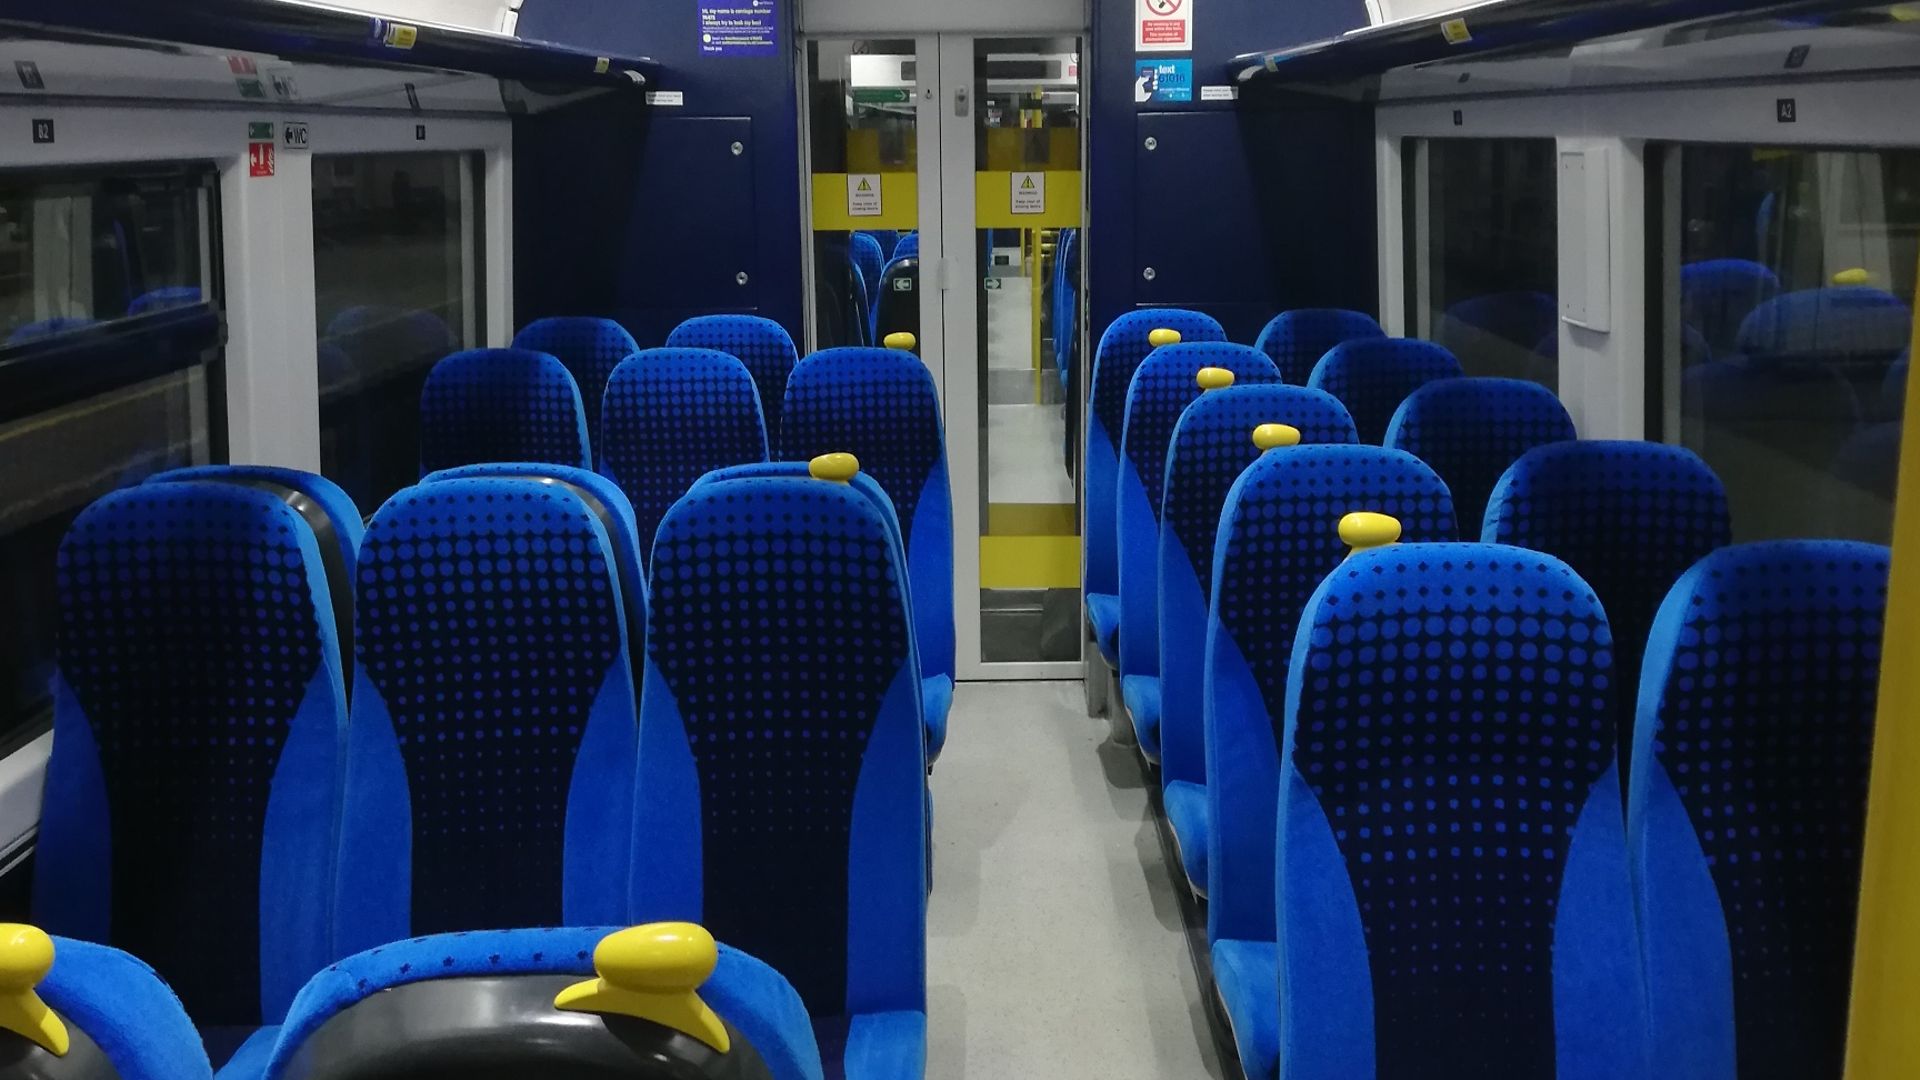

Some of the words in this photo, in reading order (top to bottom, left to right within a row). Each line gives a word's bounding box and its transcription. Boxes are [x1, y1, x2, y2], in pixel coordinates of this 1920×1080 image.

[1159, 64, 1175, 74] text
[1781, 103, 1792, 119] A2
[293, 127, 307, 144] WC
